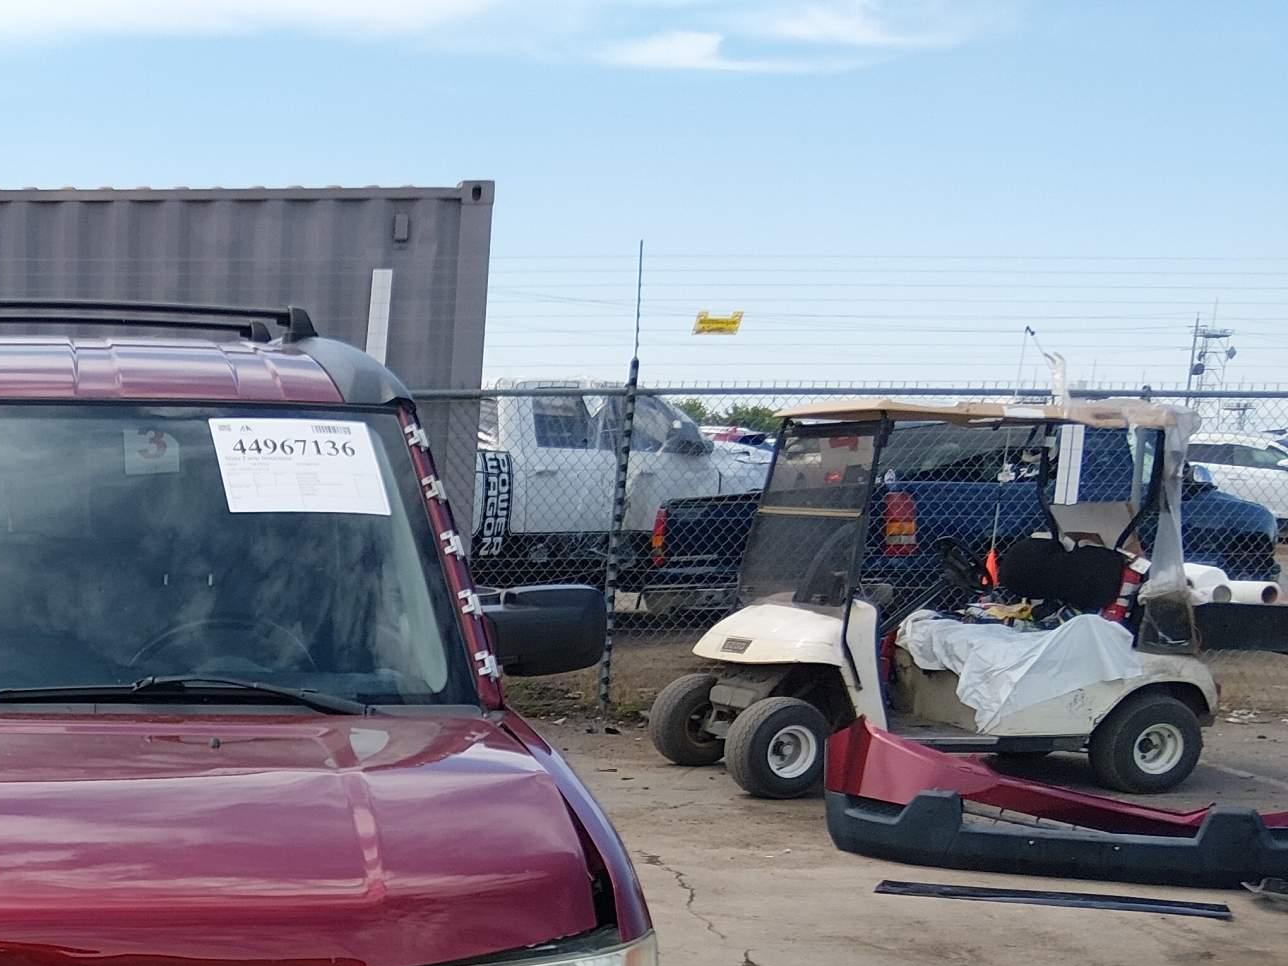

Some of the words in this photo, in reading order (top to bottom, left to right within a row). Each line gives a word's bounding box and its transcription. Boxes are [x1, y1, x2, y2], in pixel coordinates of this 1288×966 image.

[232, 437, 357, 458] 44967136
[479, 452, 499, 556] WAGON
[490, 452, 510, 556] POWER
